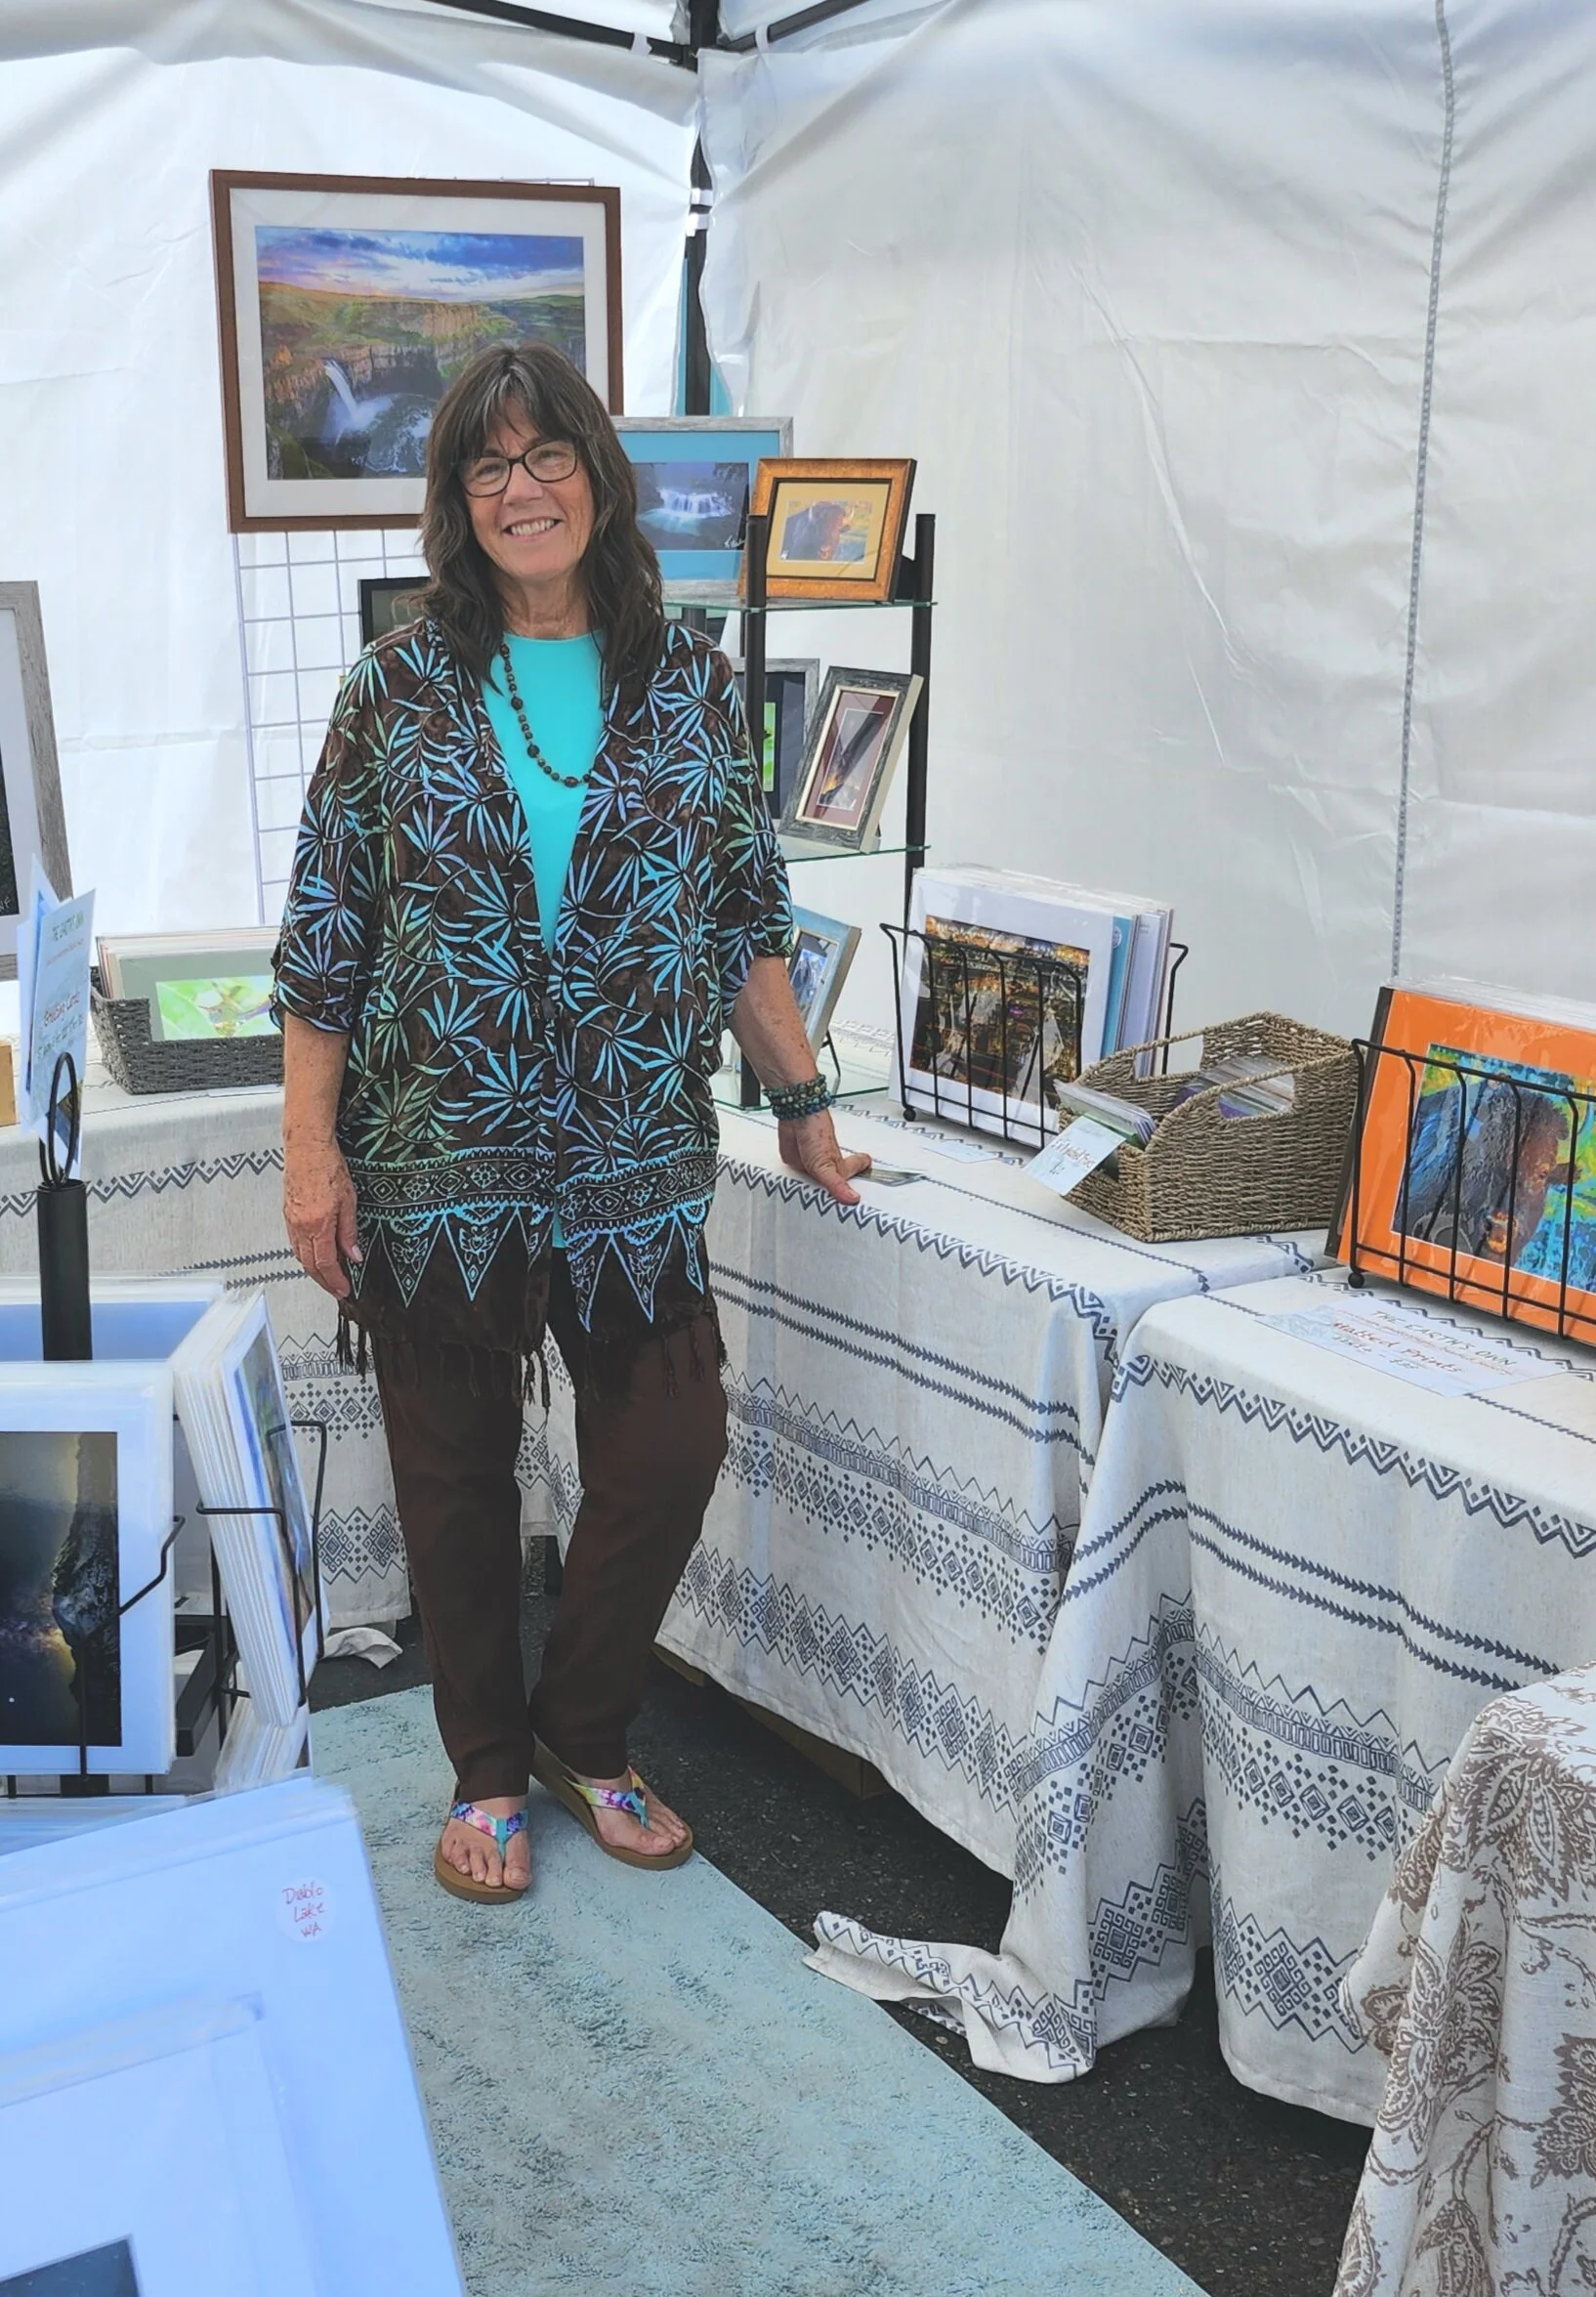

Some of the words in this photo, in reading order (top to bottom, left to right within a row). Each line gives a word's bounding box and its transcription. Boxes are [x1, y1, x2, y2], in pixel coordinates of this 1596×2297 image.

[1332, 1321, 1400, 1347] Matted
[1400, 1347, 1463, 1373] Prints
[1371, 1310, 1406, 1325] THE
[1475, 1349, 1517, 1367] OWN
